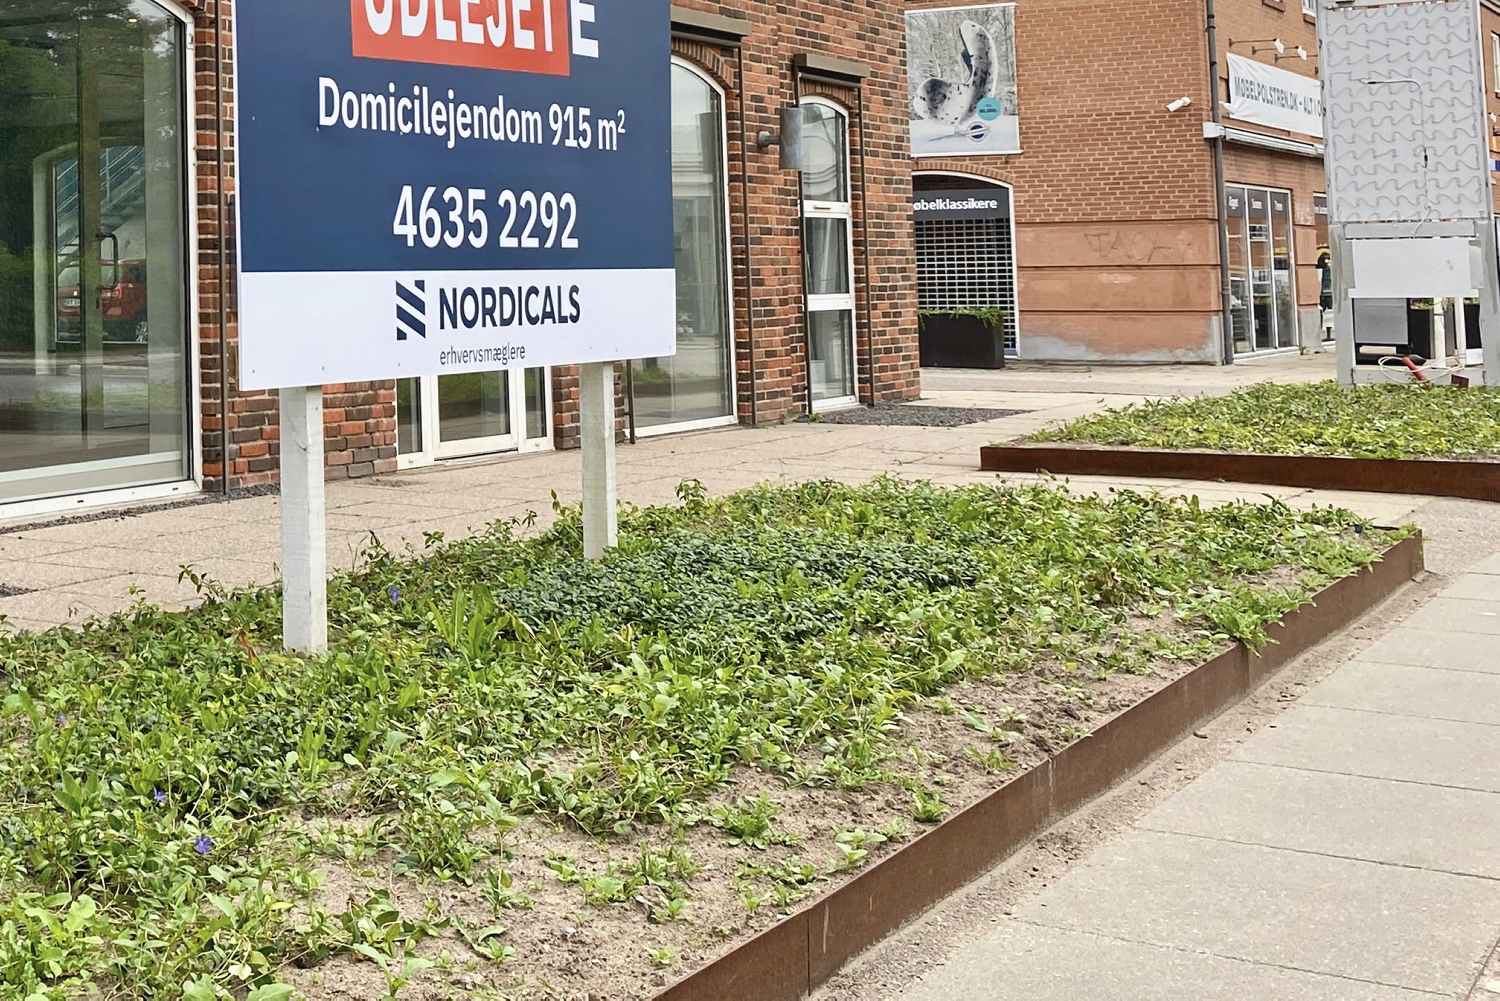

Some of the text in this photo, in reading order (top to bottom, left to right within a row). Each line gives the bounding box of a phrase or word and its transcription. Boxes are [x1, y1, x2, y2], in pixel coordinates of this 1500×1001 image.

[318, 77, 543, 149] Domicilejendom
[548, 105, 592, 149] 915
[393, 184, 579, 249] 4635 2292
[913, 198, 997, 210] øbelklassikere
[439, 285, 581, 330] NORDICALS
[439, 343, 526, 366] erhvervsmæglere
